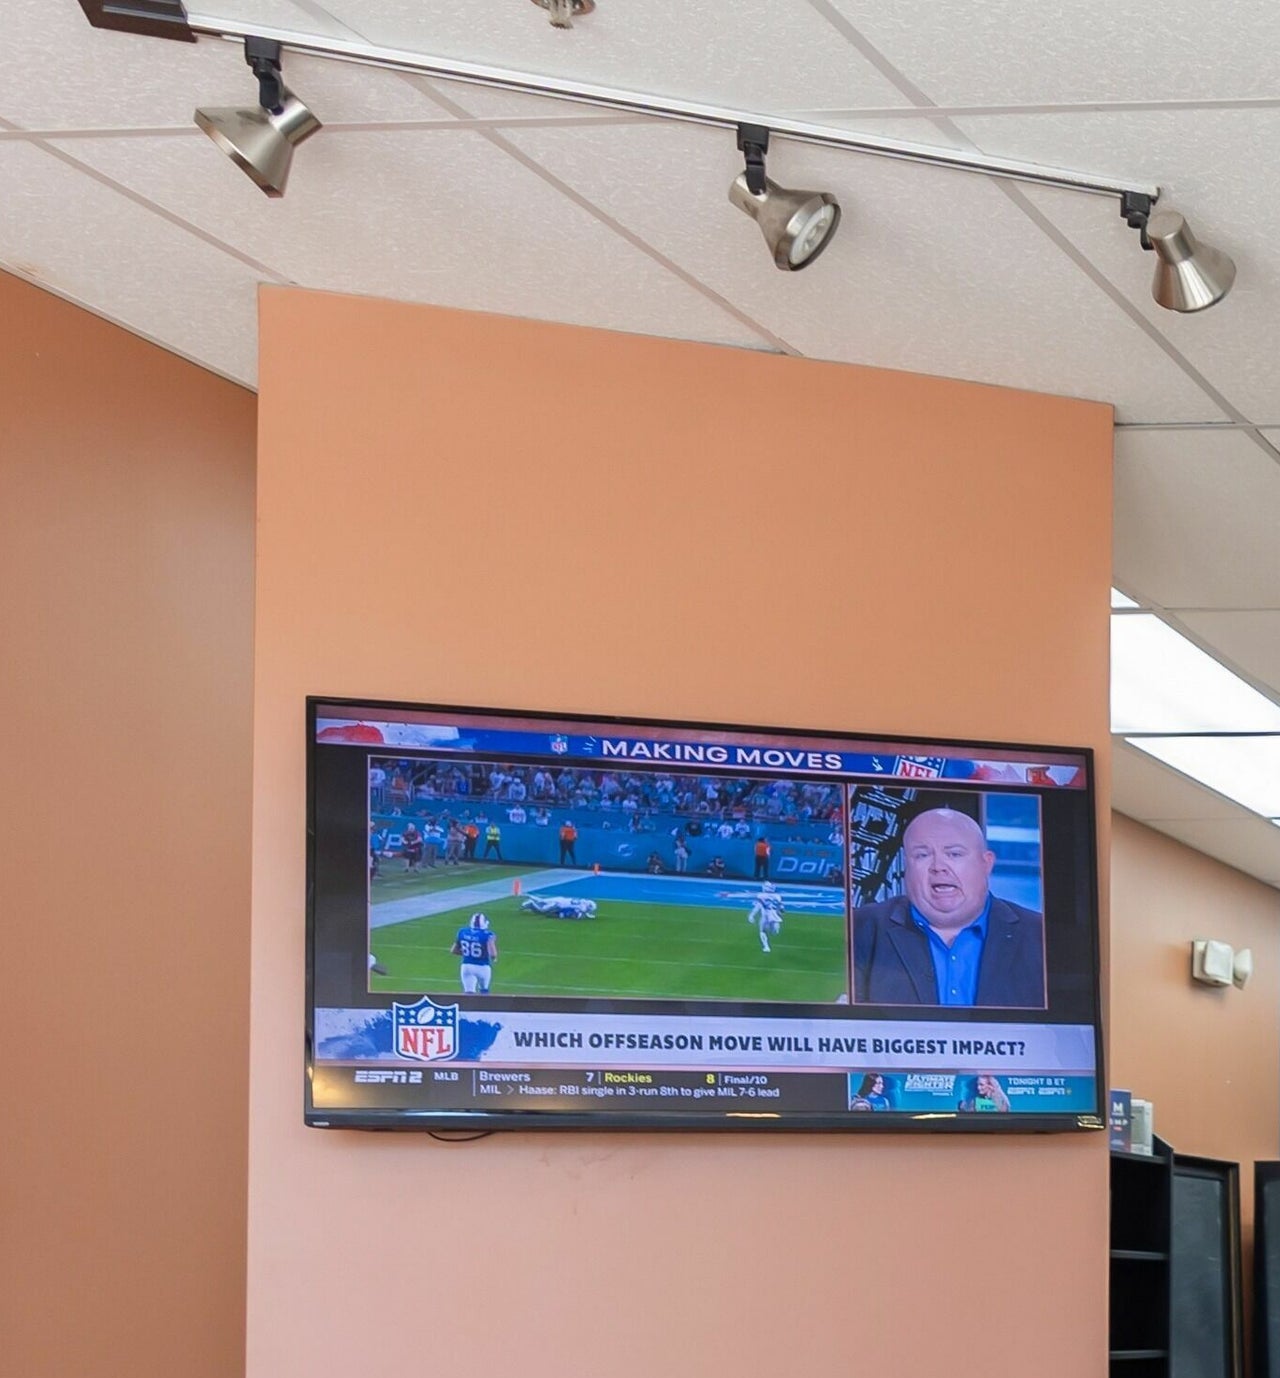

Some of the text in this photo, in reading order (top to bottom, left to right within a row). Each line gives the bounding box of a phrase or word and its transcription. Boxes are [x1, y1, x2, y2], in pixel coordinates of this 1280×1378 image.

[601, 739, 843, 770] MAKING MOVES
[400, 1027, 451, 1058] NFL
[513, 1031, 1026, 1056] WHICH OFFSEASON MOVE WILL HAVE BIGGEST IMPACT?
[433, 1072, 459, 1081] MLB
[479, 1071, 768, 1085] Brewers 7 Rockies 8 Final/10
[479, 1084, 502, 1095] MIL
[559, 1085, 580, 1095] RBI
[581, 1086, 614, 1098] single
[616, 1086, 626, 1096] in
[628, 1086, 658, 1096] 3-run
[680, 1087, 692, 1097] to
[693, 1087, 715, 1099] give
[757, 1087, 780, 1098] lead
